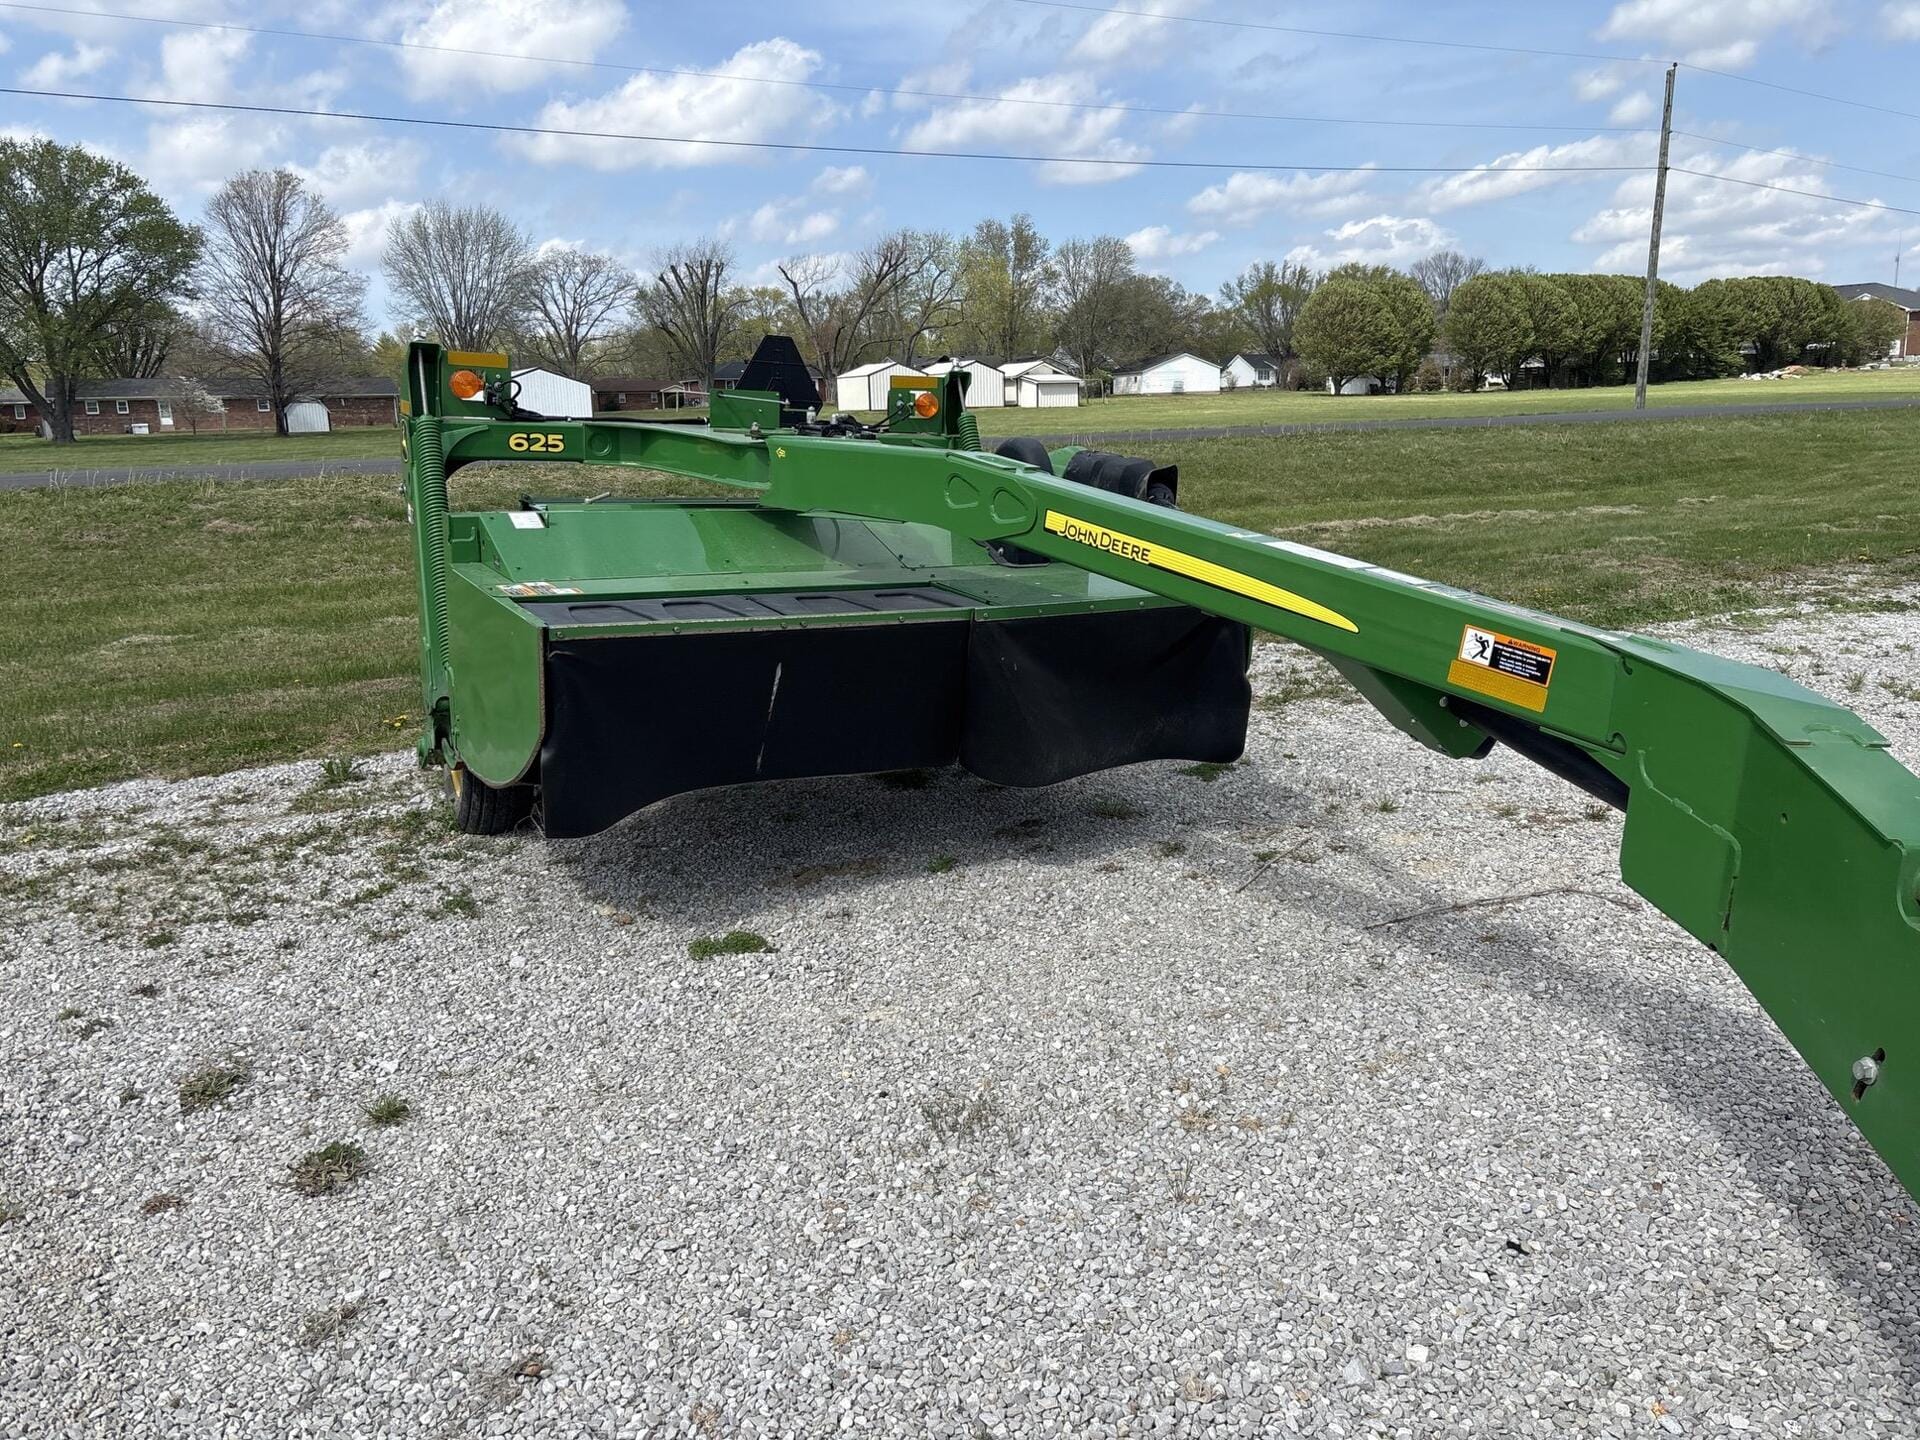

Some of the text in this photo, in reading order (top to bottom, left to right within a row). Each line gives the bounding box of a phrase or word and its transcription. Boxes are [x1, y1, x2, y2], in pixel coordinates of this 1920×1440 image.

[508, 432, 565, 453] 625
[1058, 519, 1151, 562] JOHN DEERE
[1512, 640, 1541, 654] WARNING
